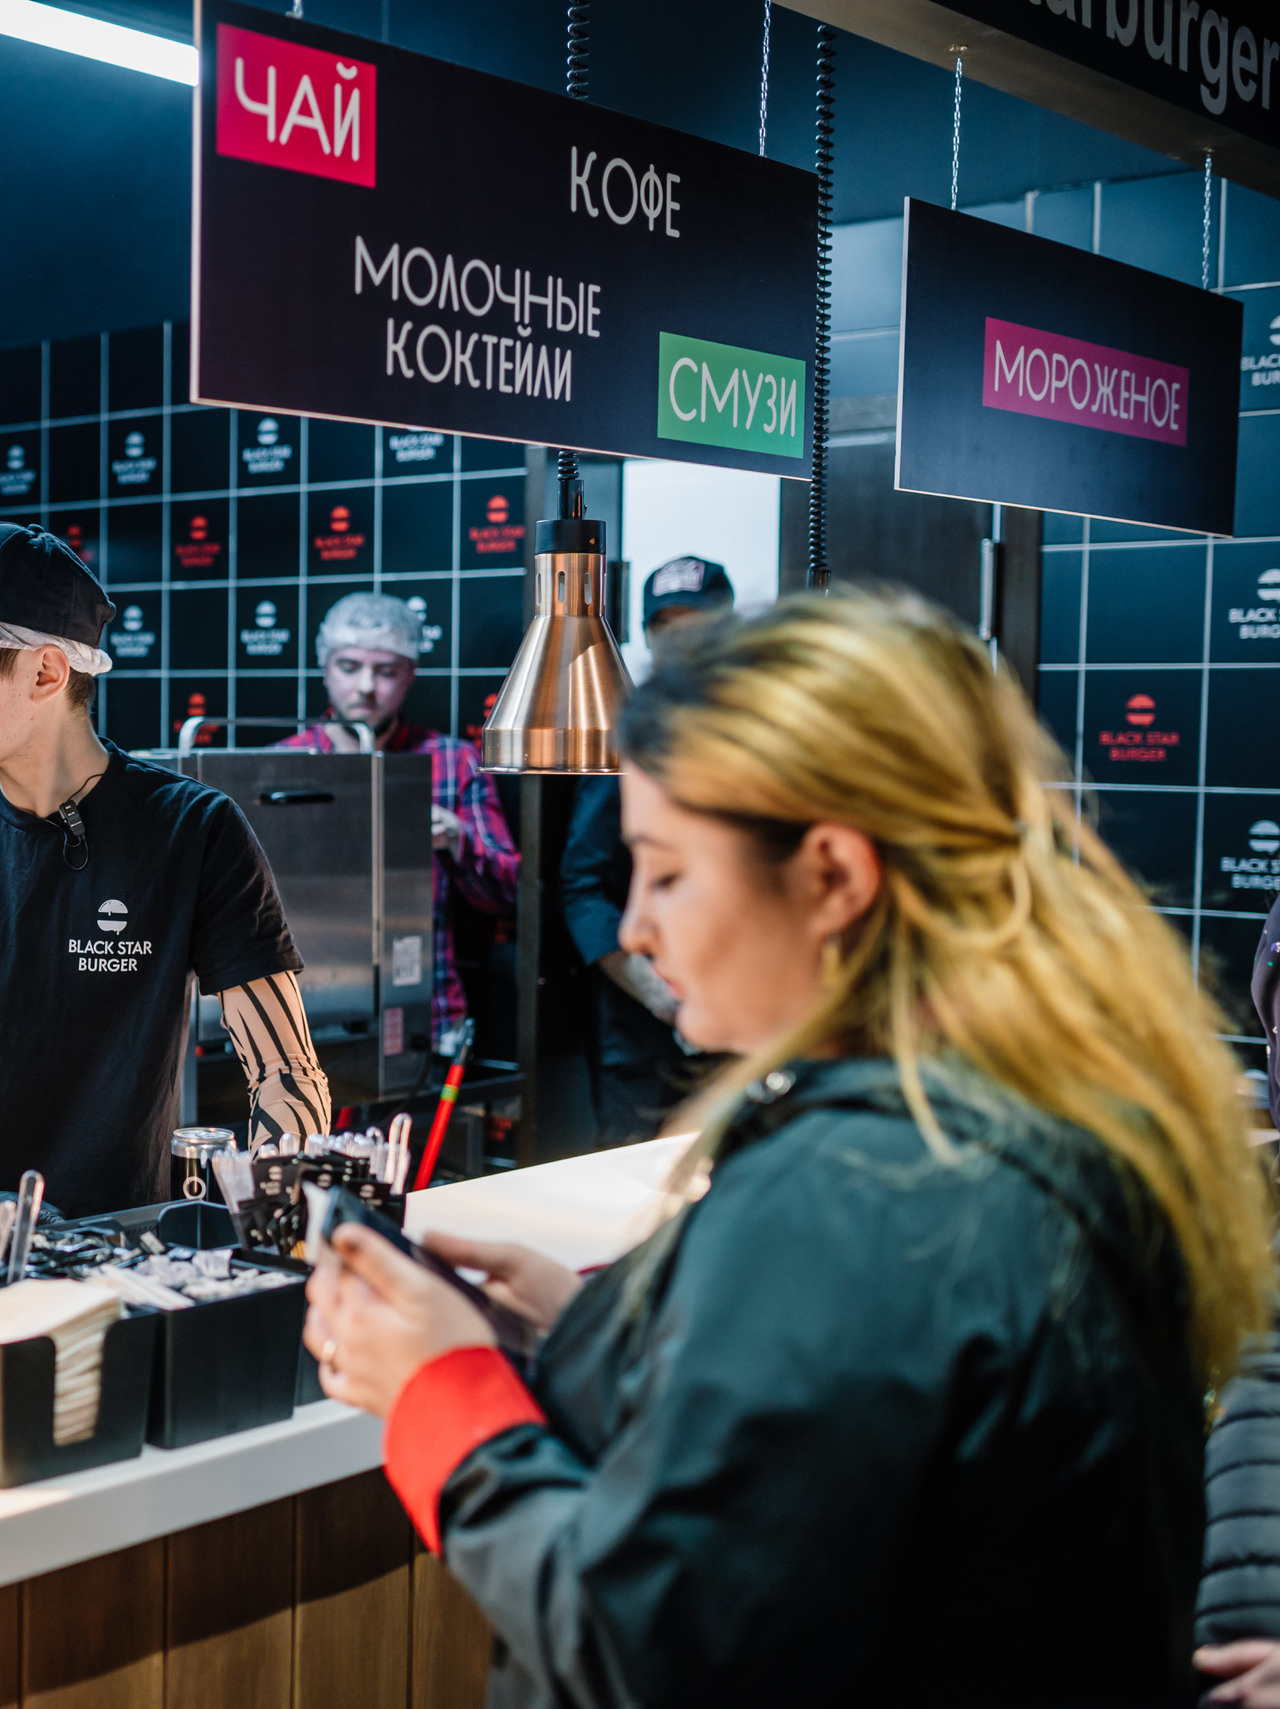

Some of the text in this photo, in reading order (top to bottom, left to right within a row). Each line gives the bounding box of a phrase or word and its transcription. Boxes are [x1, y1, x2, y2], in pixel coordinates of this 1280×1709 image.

[235, 57, 360, 162] ЧАЙ
[570, 145, 681, 238] КОФЕ
[354, 235, 601, 338] МОЛОЧНЫЕ
[386, 317, 572, 402] КОКТЕЙЛИ
[669, 357, 797, 437] СМУЗИ
[992, 339, 1181, 431] МОРОЖЕНОЕ
[1240, 354, 1280, 371] BLAC
[1239, 624, 1280, 639] BURG
[1232, 873, 1280, 890] BURGE
[68, 939, 153, 955] BLACK STAR
[78, 957, 138, 972] BURGER
